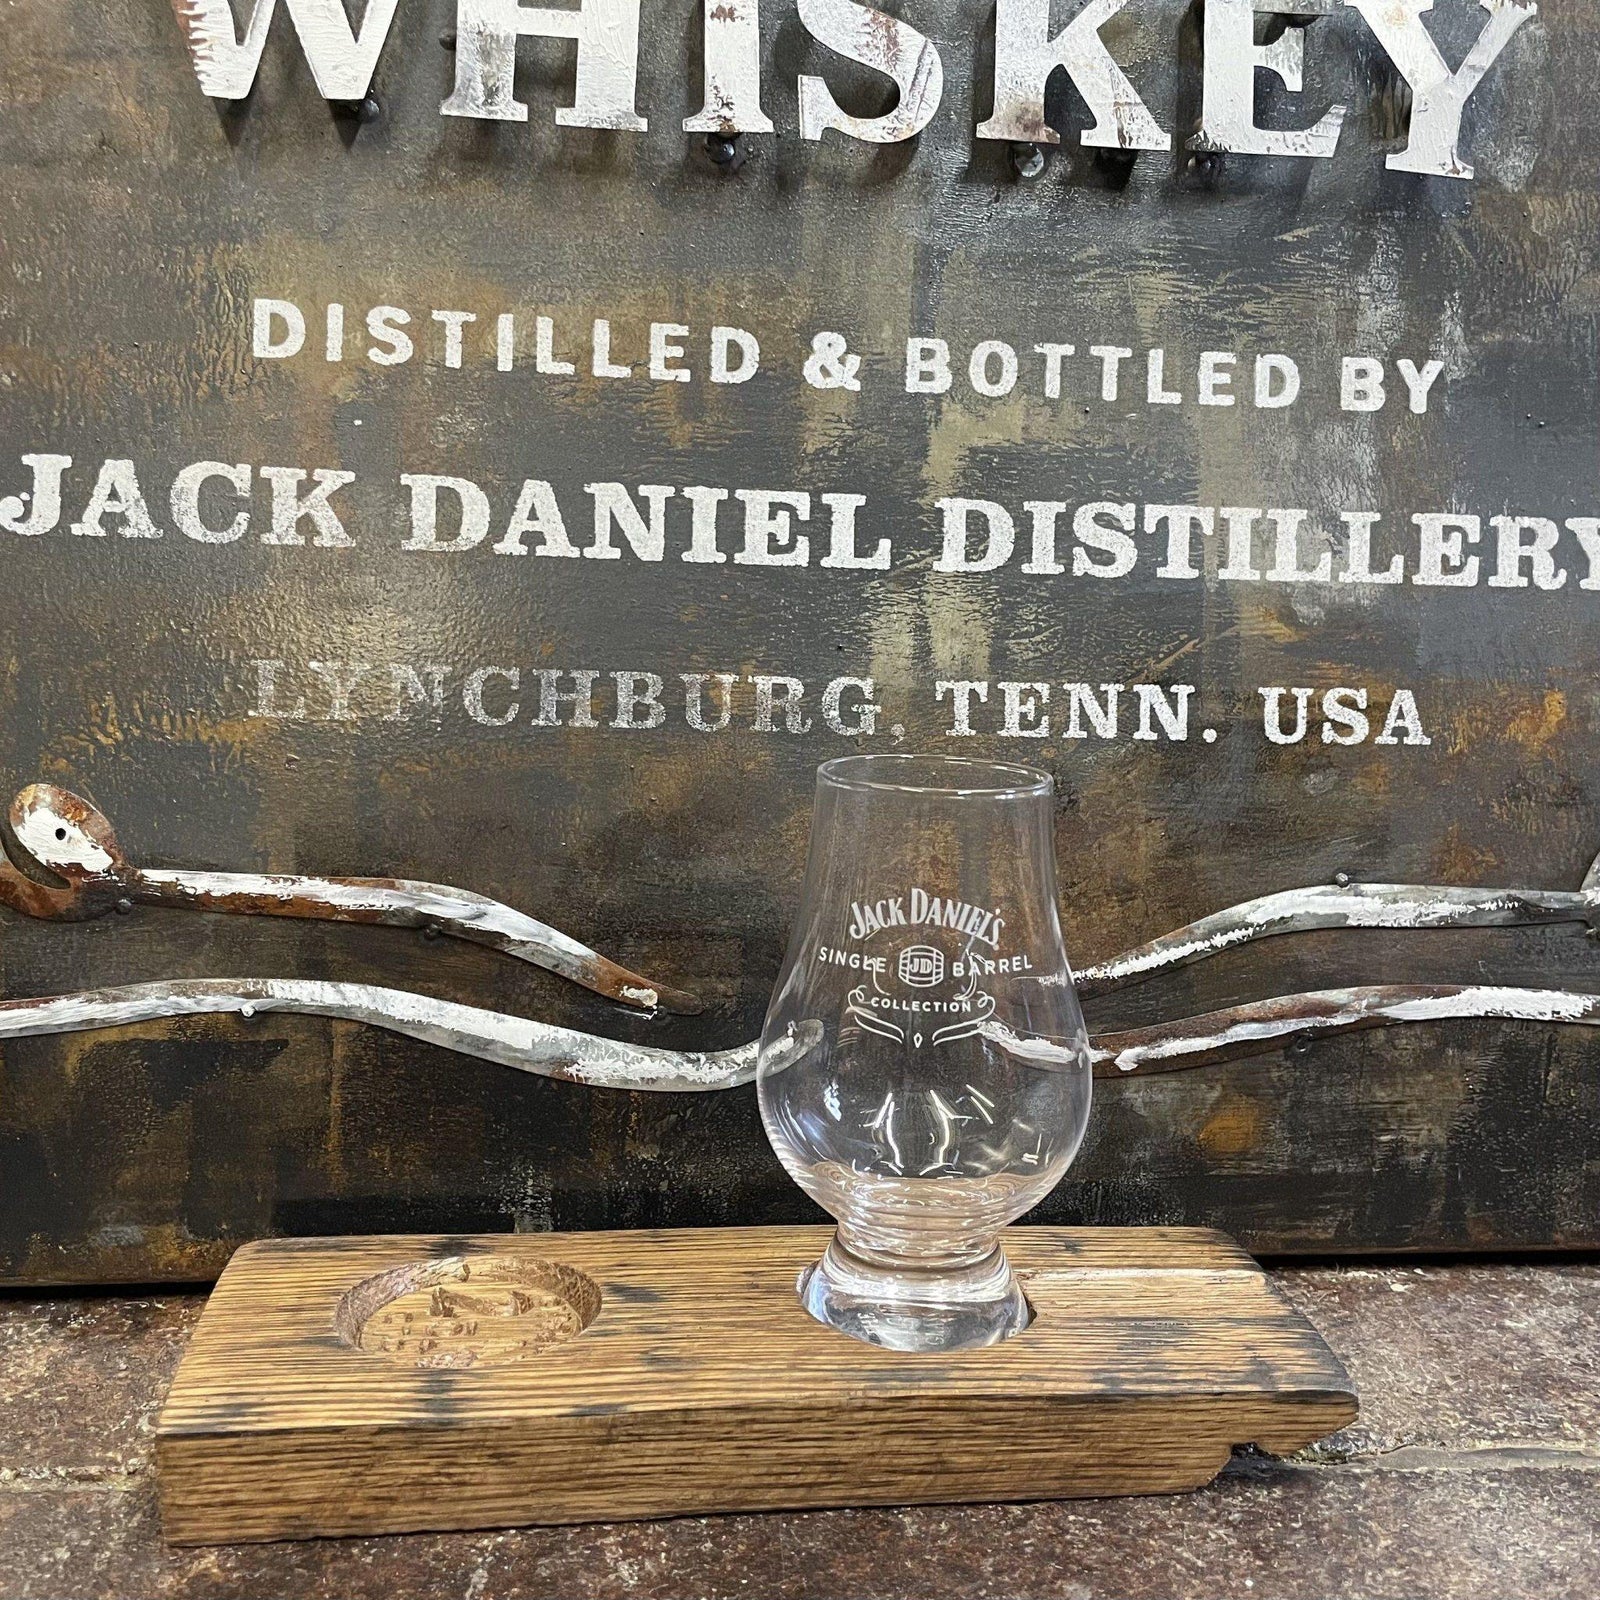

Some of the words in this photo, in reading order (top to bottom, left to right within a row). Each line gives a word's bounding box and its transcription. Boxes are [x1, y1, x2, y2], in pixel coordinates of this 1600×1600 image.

[252, 298, 760, 384] DISTILLED
[801, 331, 862, 393] &
[904, 336, 1302, 410] BOTTLED
[1339, 356, 1445, 415] BY
[0, 454, 356, 547] JACK
[400, 473, 892, 571] DANIEL
[935, 680, 1219, 744] TENN.
[1257, 685, 1432, 747] USA
[818, 947, 887, 973] SINGLE
[952, 954, 1033, 977] BARREL
[871, 996, 972, 1013] COLLECTION
